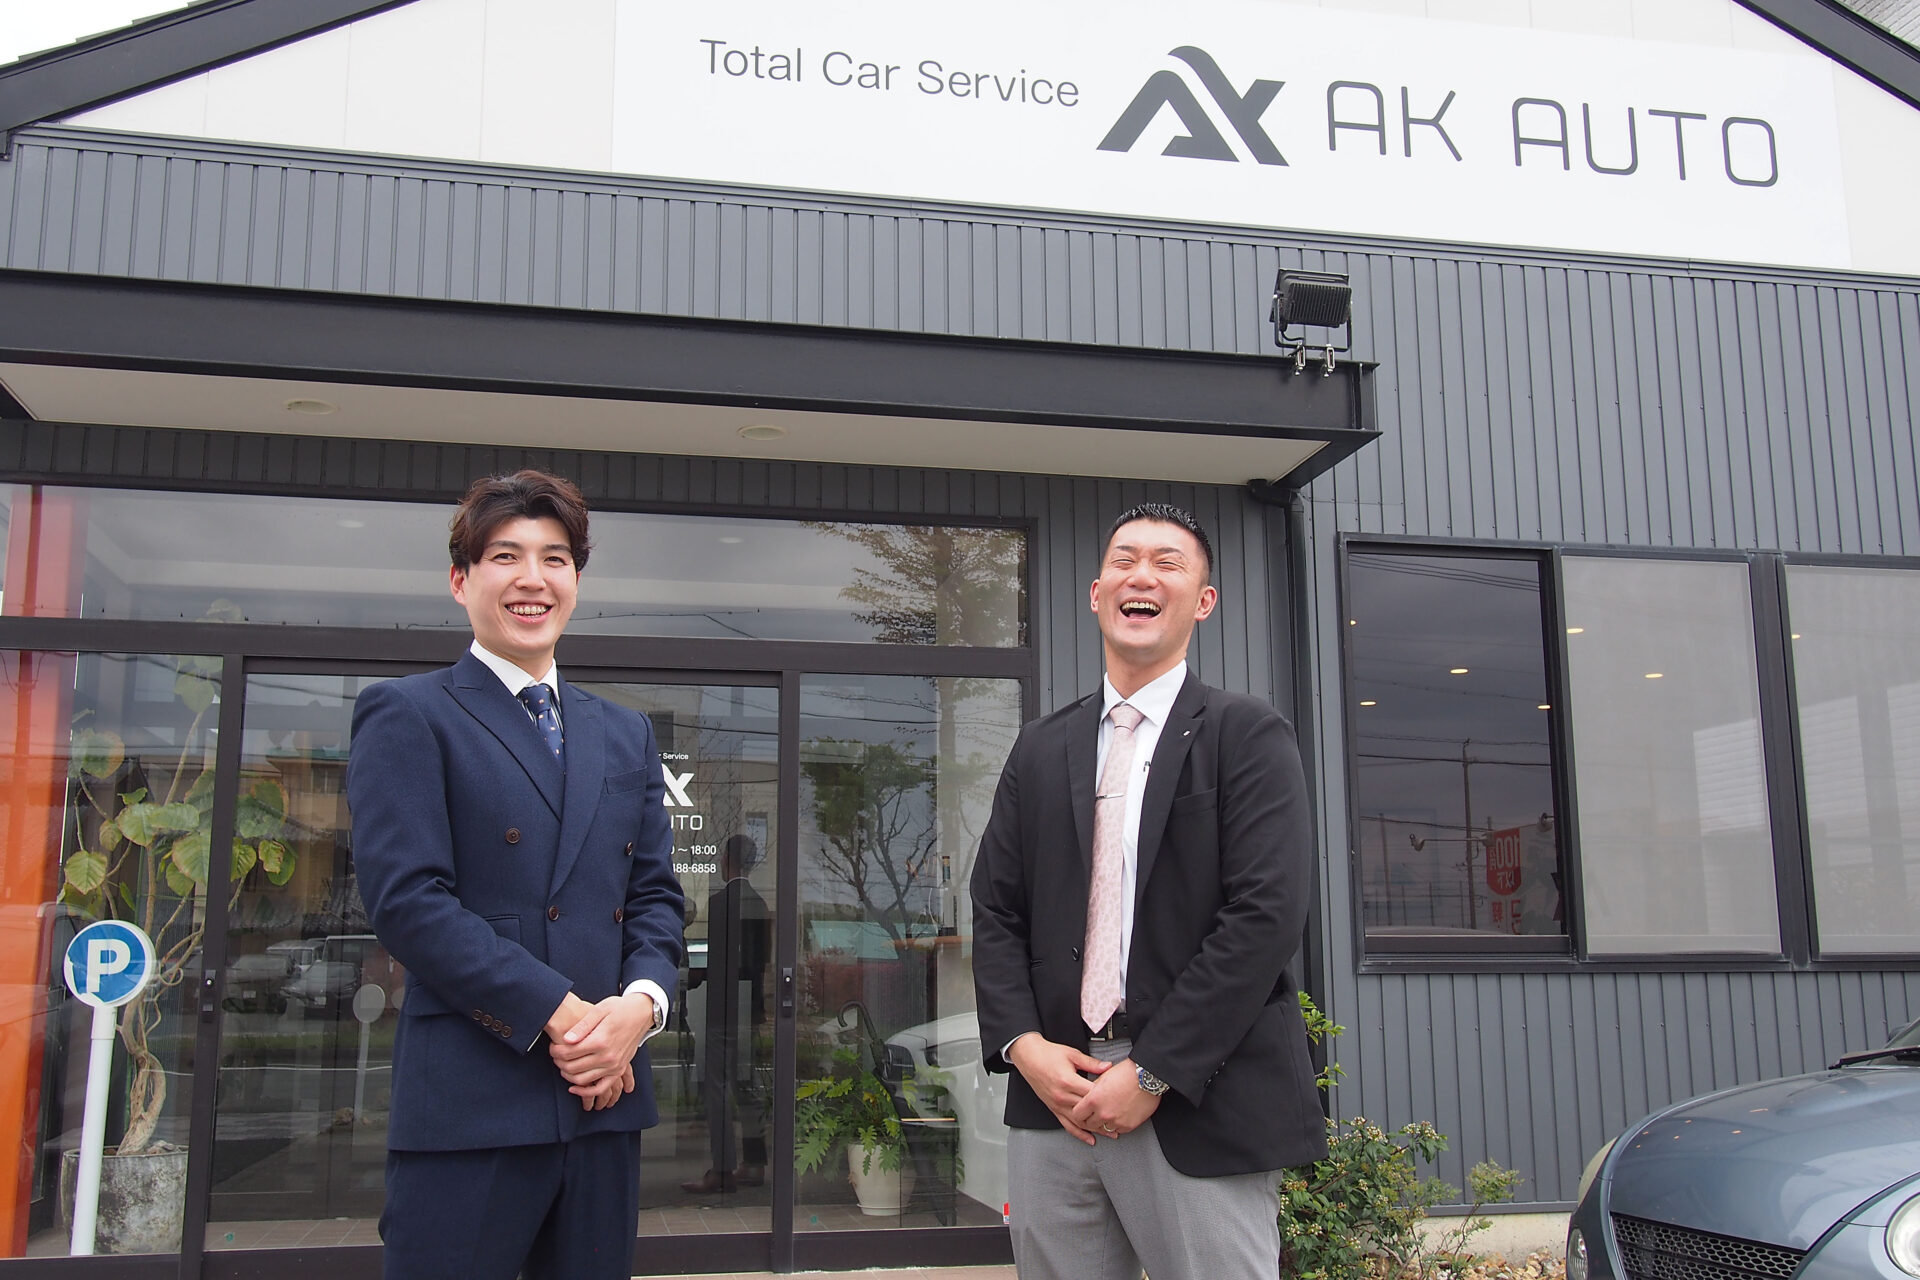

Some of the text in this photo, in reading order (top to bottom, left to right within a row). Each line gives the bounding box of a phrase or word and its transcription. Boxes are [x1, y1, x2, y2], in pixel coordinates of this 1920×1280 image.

[700, 39, 1078, 107] Total Car Service
[1327, 81, 1778, 187] AK AUTO
[662, 752, 689, 760] Service
[671, 814, 703, 830] TO
[690, 844, 717, 855] 18:00
[673, 863, 717, 873] 88-6858
[86, 939, 131, 993] P
